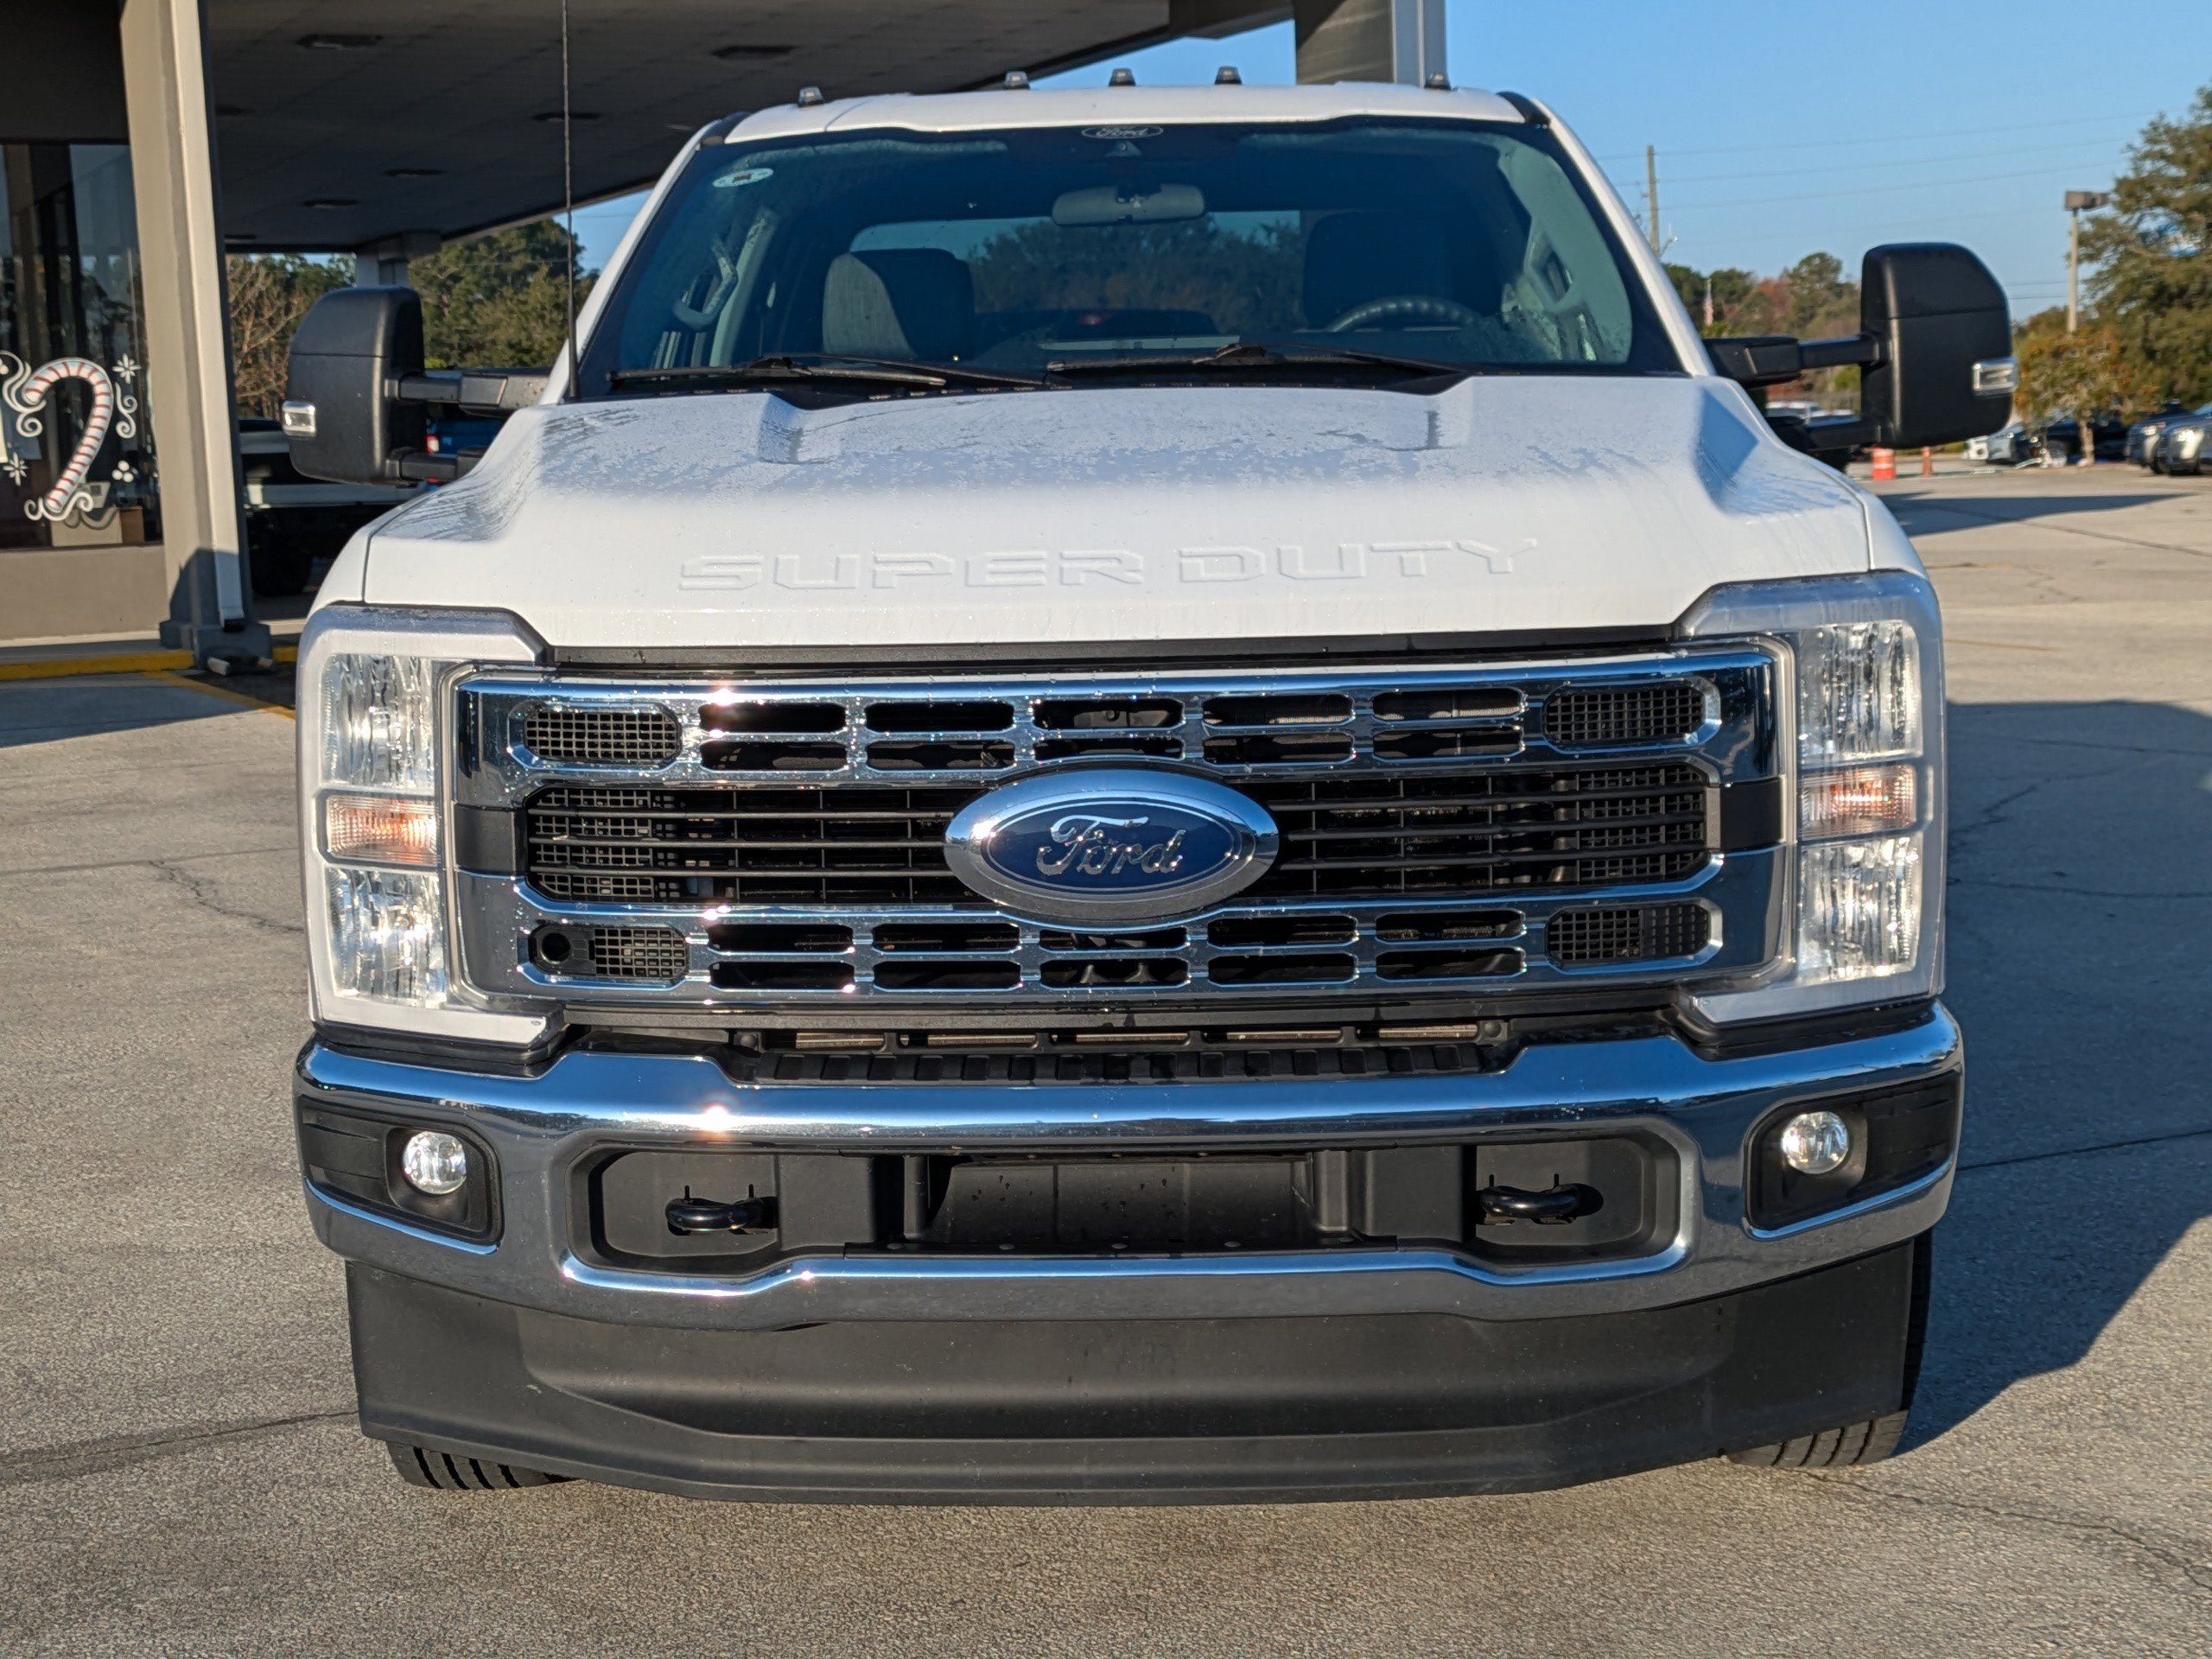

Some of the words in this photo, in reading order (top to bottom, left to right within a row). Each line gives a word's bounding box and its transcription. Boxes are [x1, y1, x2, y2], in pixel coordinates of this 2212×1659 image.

[680, 550, 1145, 590] SUPER
[1179, 538, 1538, 583] DUTY
[1037, 814, 1186, 875] Ford
